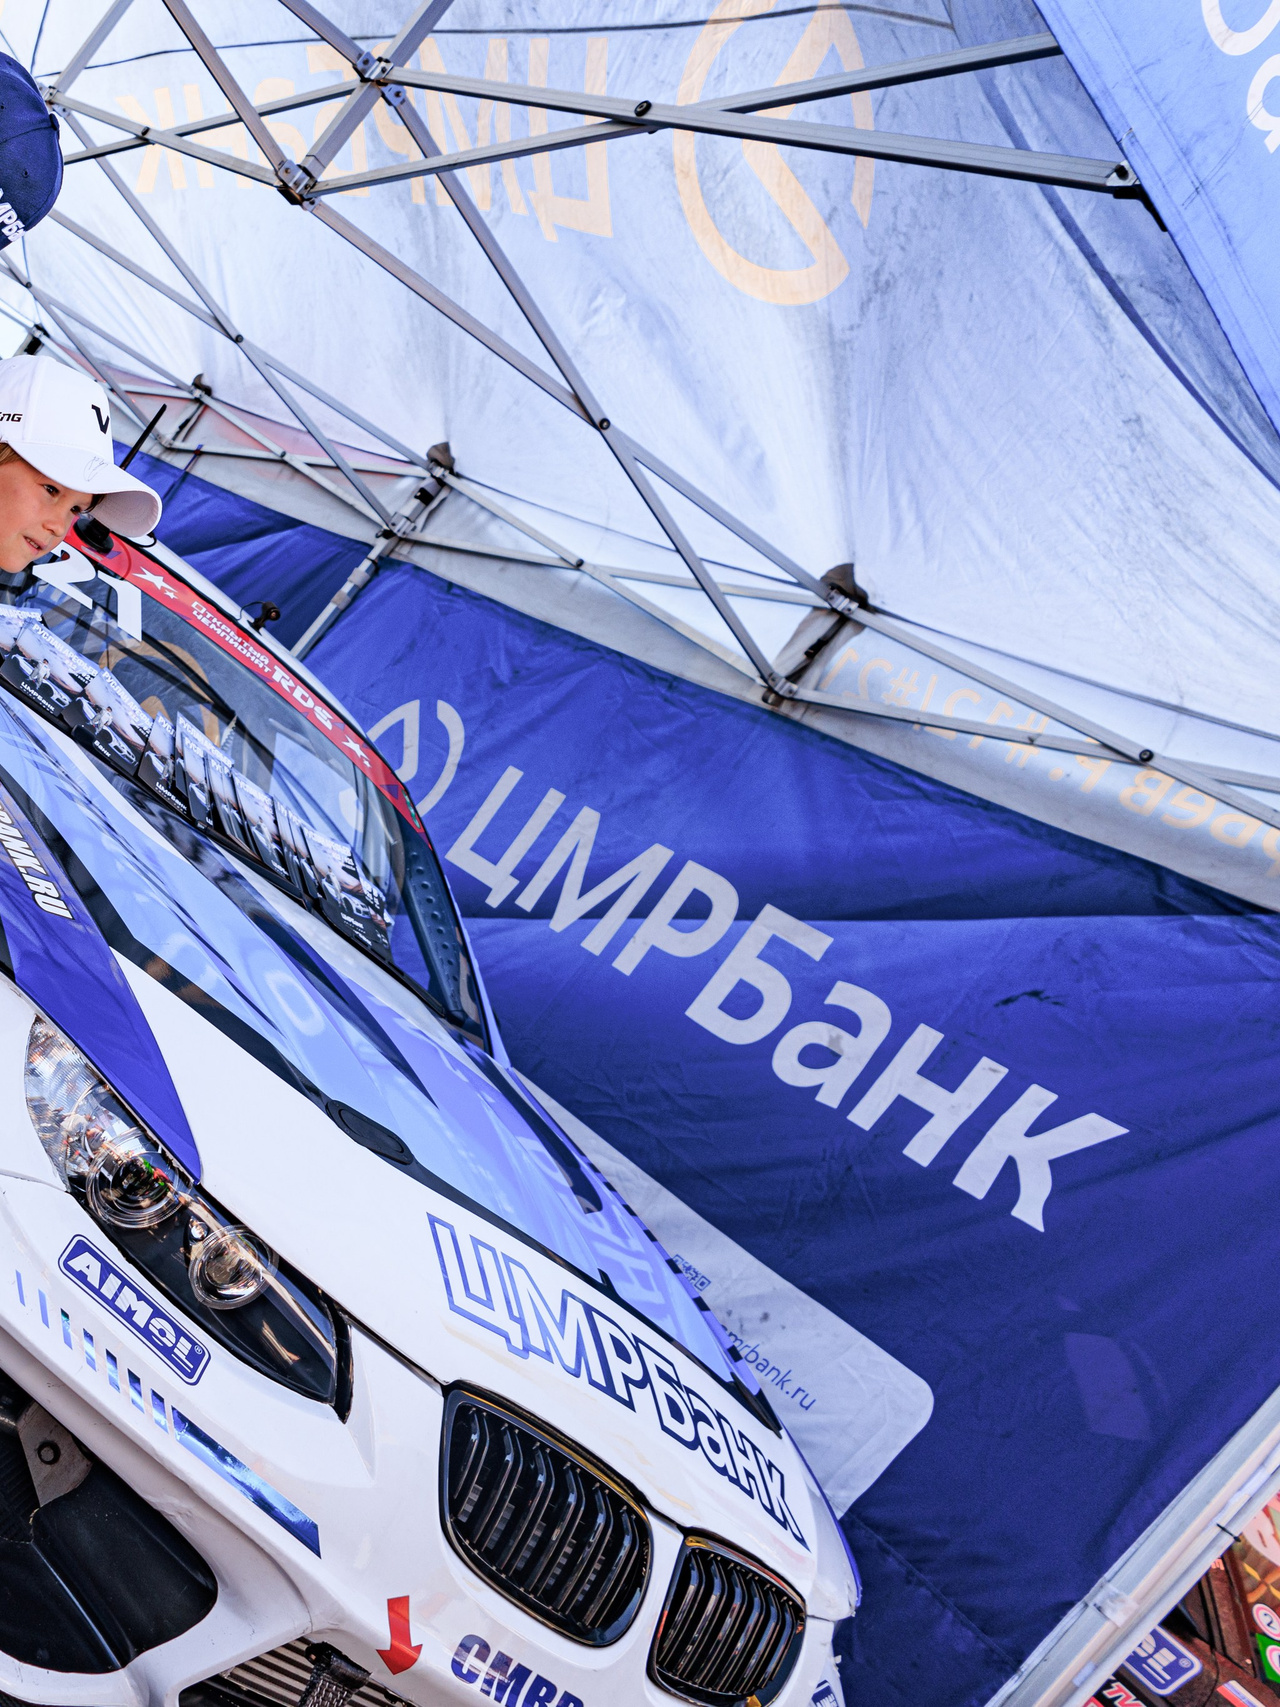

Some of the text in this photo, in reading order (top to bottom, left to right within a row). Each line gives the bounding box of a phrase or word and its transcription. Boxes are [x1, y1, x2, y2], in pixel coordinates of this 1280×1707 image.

[32, 541, 142, 642] 21
[32, 623, 99, 677] РУСЛАН АРЕФЬЕВ
[102, 670, 129, 704] РУСЛАН
[272, 664, 334, 731] RDS
[444, 765, 1129, 1232] ЦМРБанк
[426, 1212, 812, 1553] ЦМРБанк
[721, 1324, 817, 1412] mrbank.ru
